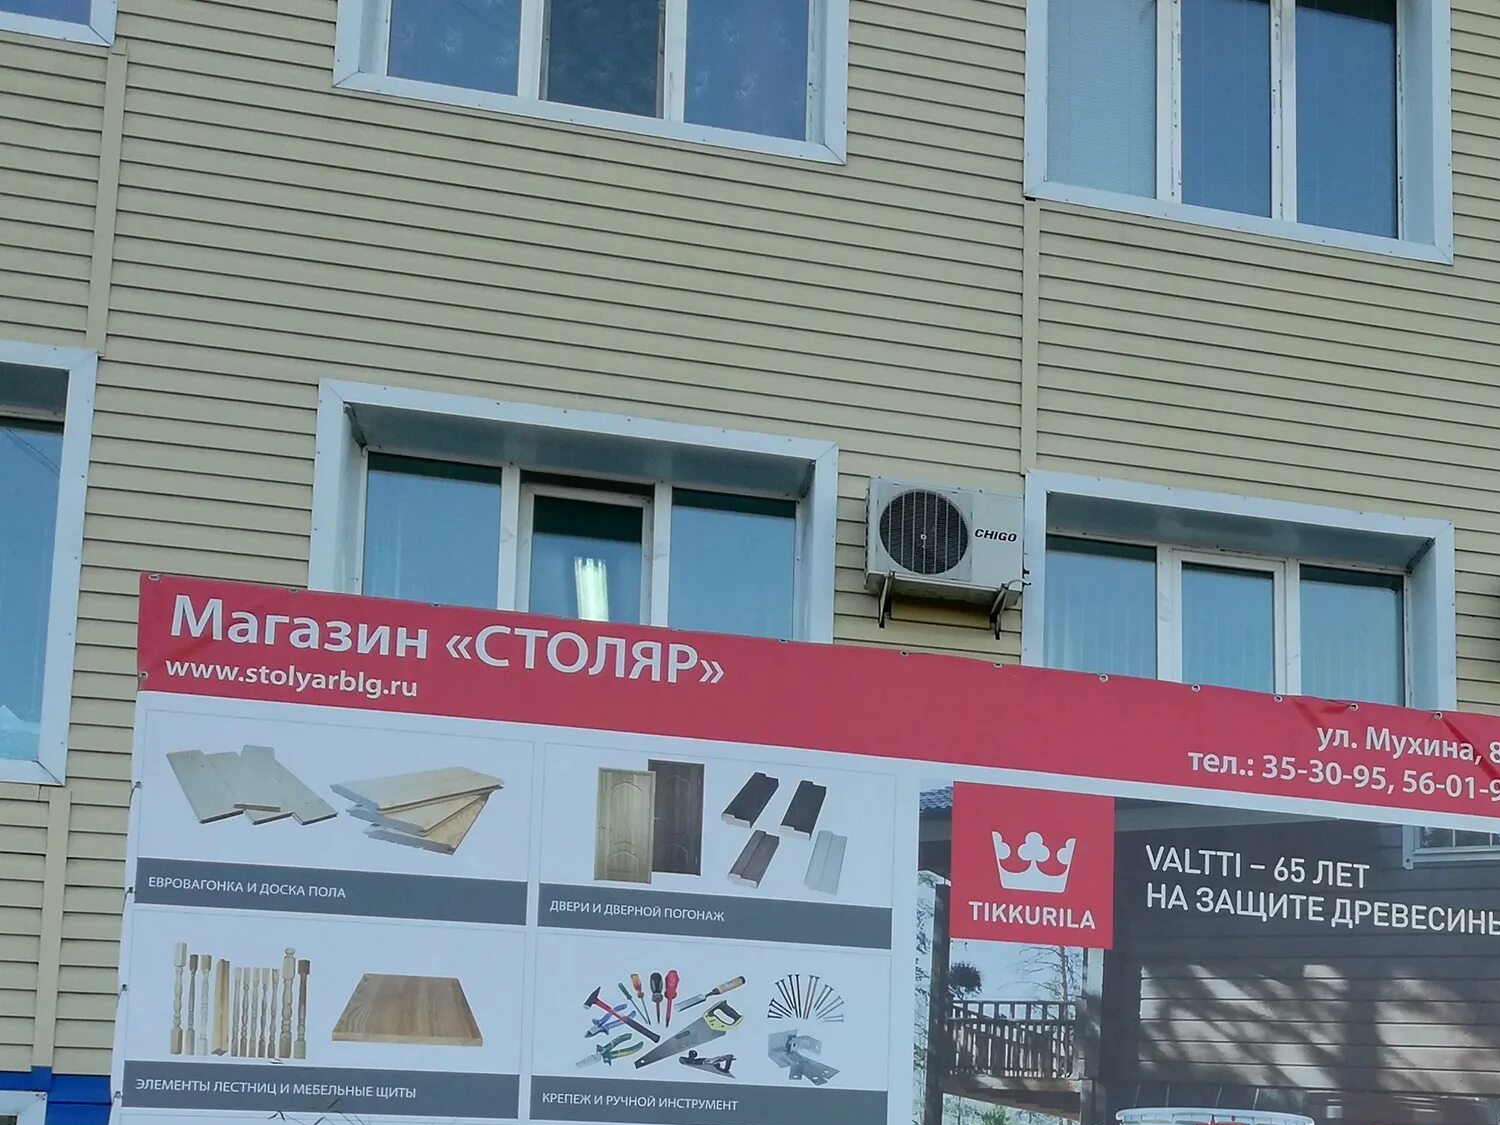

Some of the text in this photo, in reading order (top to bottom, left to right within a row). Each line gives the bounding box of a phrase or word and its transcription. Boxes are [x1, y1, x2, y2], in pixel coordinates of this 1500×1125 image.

[975, 529, 1017, 542] CHIGO
[170, 595, 724, 686] Магазин «СТОЛЯР»
[165, 660, 418, 699] www.stolyarblg.ru
[1316, 725, 1358, 752] ул.
[1366, 726, 1483, 765] Мухина,
[1188, 751, 1255, 777] тел.:
[1262, 756, 1395, 796] 35-30-95,
[1145, 844, 1242, 879] VALTTI
[1273, 857, 1306, 883] 65
[1312, 860, 1370, 889] ЛЕТ
[148, 876, 346, 898] ЕВРОВАГОНКА И ДОСКА ПОЛА
[1147, 882, 1189, 911] НА
[1195, 886, 1325, 923] ЗАЩИТЕ
[549, 900, 725, 922] ДВЕРИ И ДВЕРНОЙ ПОГОНАЖ
[968, 900, 1096, 930] TIKKURILA
[135, 1078, 417, 1099] ЭЛЕМЕНТЫ ЛЕСТНИЦ И МЕБЕЛЬНЫЕ ЩИТЫ
[542, 1092, 739, 1111] КРЕПЕЖ И РУЧНОЙ ИНСТРУМЕНТ
